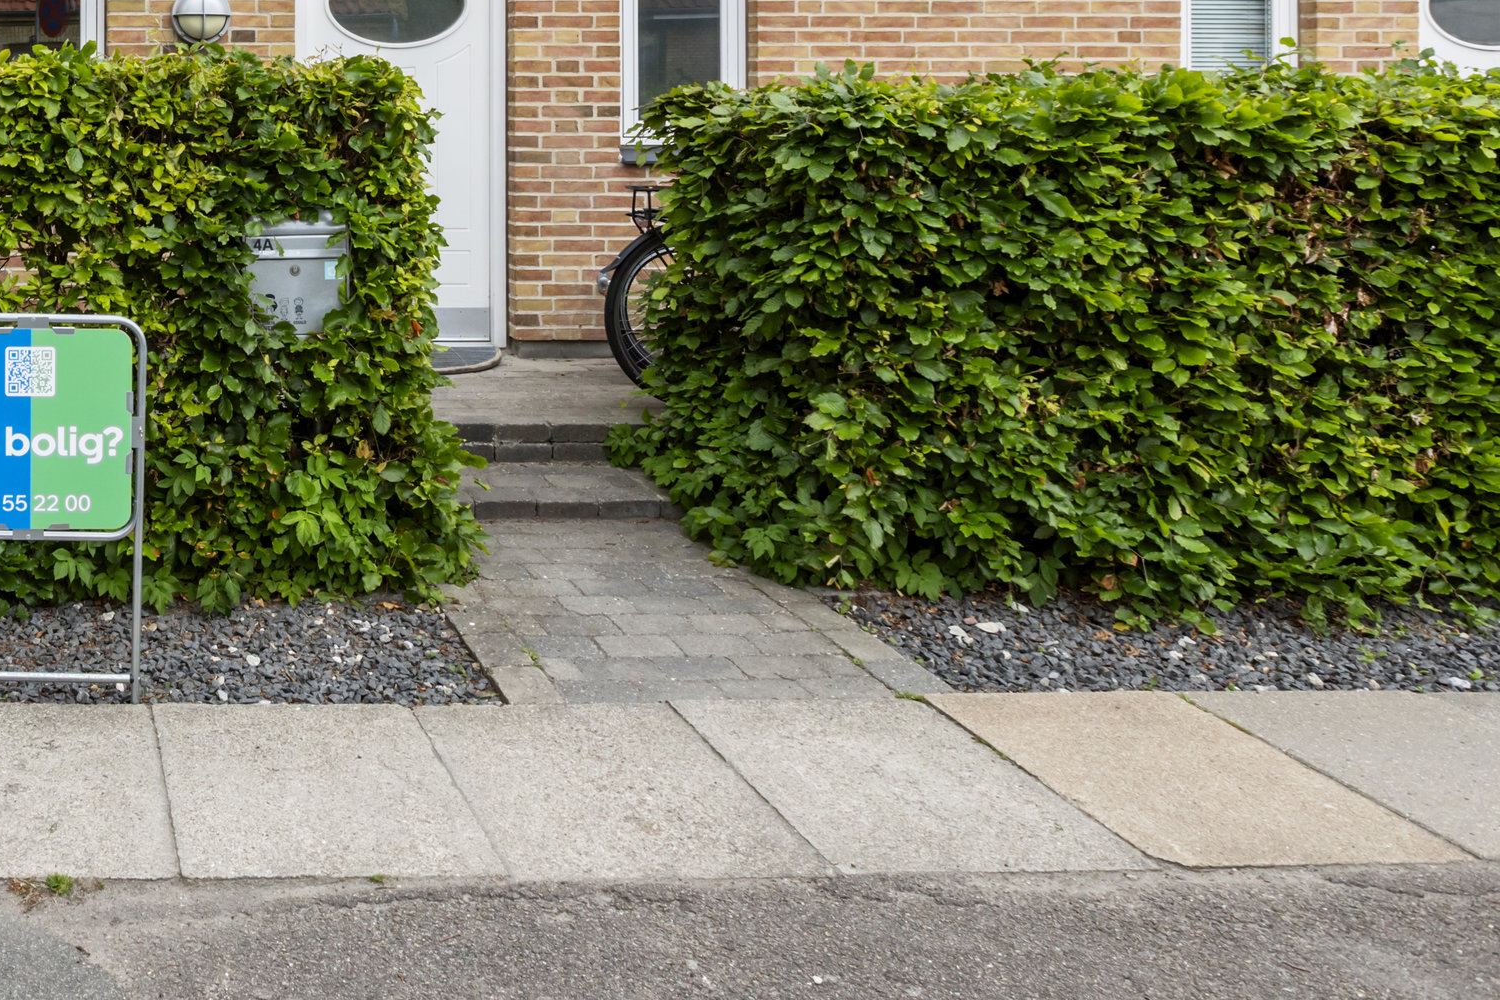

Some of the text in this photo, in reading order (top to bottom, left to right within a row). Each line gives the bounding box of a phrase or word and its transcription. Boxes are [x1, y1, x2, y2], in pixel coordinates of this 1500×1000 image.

[253, 238, 274, 251] 4A
[5, 425, 124, 466] bolig?
[2, 494, 28, 512] 55
[33, 494, 59, 512] 22
[65, 494, 91, 512] 00
